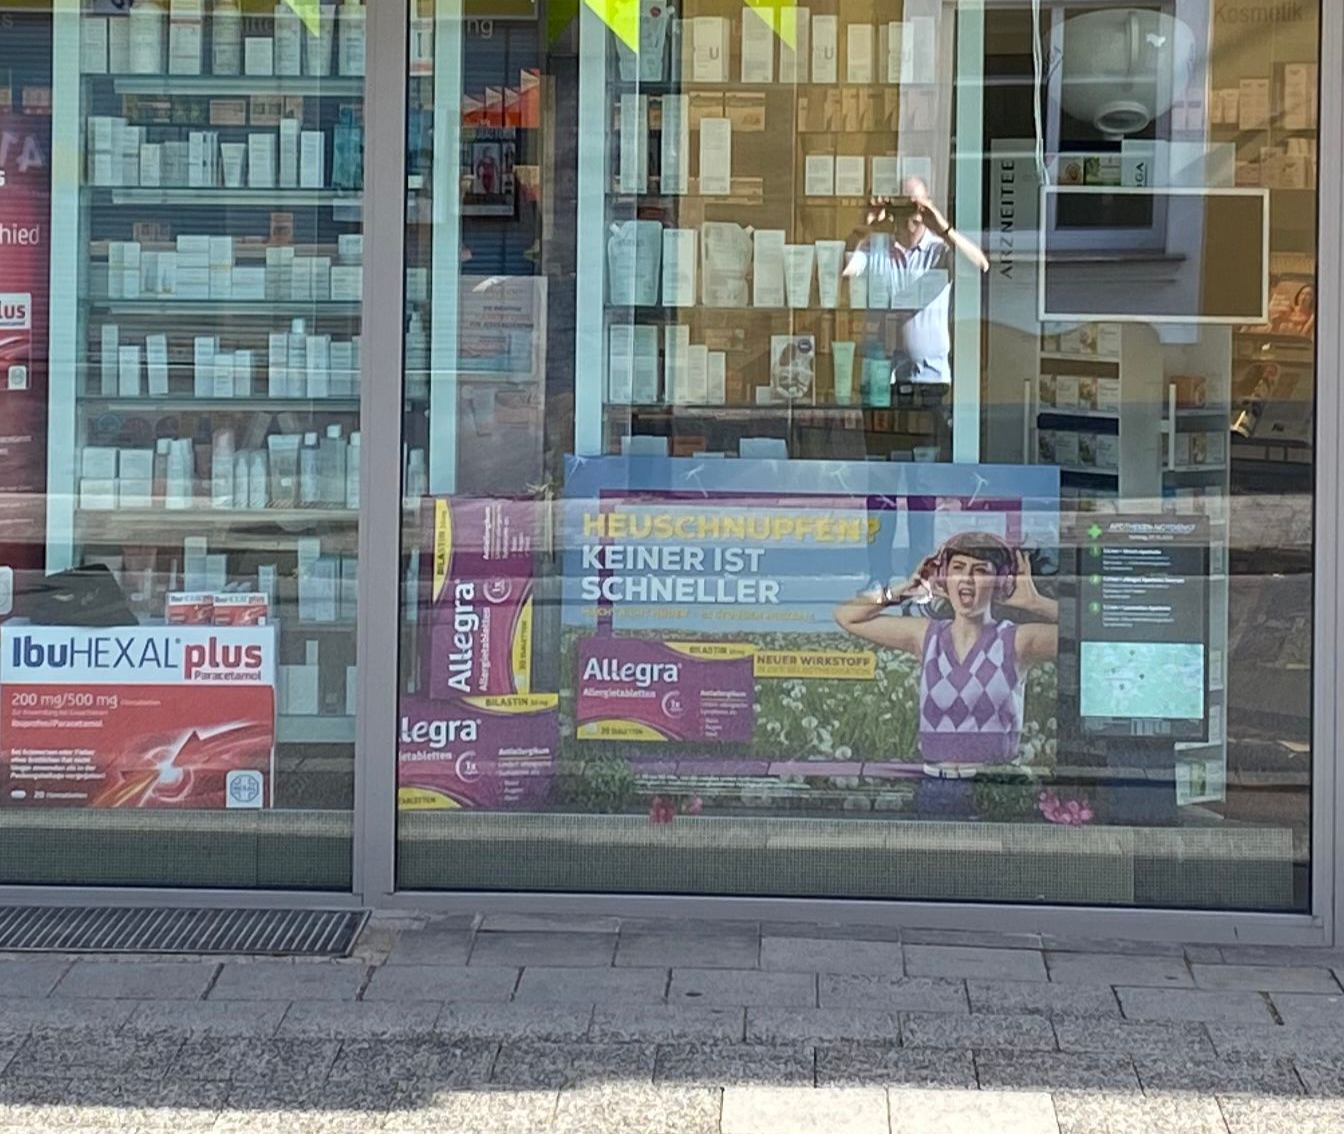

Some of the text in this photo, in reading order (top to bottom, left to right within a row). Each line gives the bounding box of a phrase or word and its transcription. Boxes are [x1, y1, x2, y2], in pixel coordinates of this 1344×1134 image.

[1214, 0, 1303, 24] Kosmetik
[999, 159, 1015, 280] ARZNEITEE
[583, 512, 882, 544] HEUSCHNUPFEN?
[581, 545, 765, 572] KEINER IST
[581, 576, 780, 604] SCHNELLER
[448, 582, 480, 693] Allegra
[184, 636, 263, 680] plus
[583, 657, 678, 687] Allegra
[757, 655, 871, 667] NEUER WIRKSTOFF
[193, 670, 262, 681] Paracetamol
[11, 692, 118, 710] 200 mg/500 mg
[485, 697, 528, 707] BILASTIN
[399, 716, 478, 749] legra
